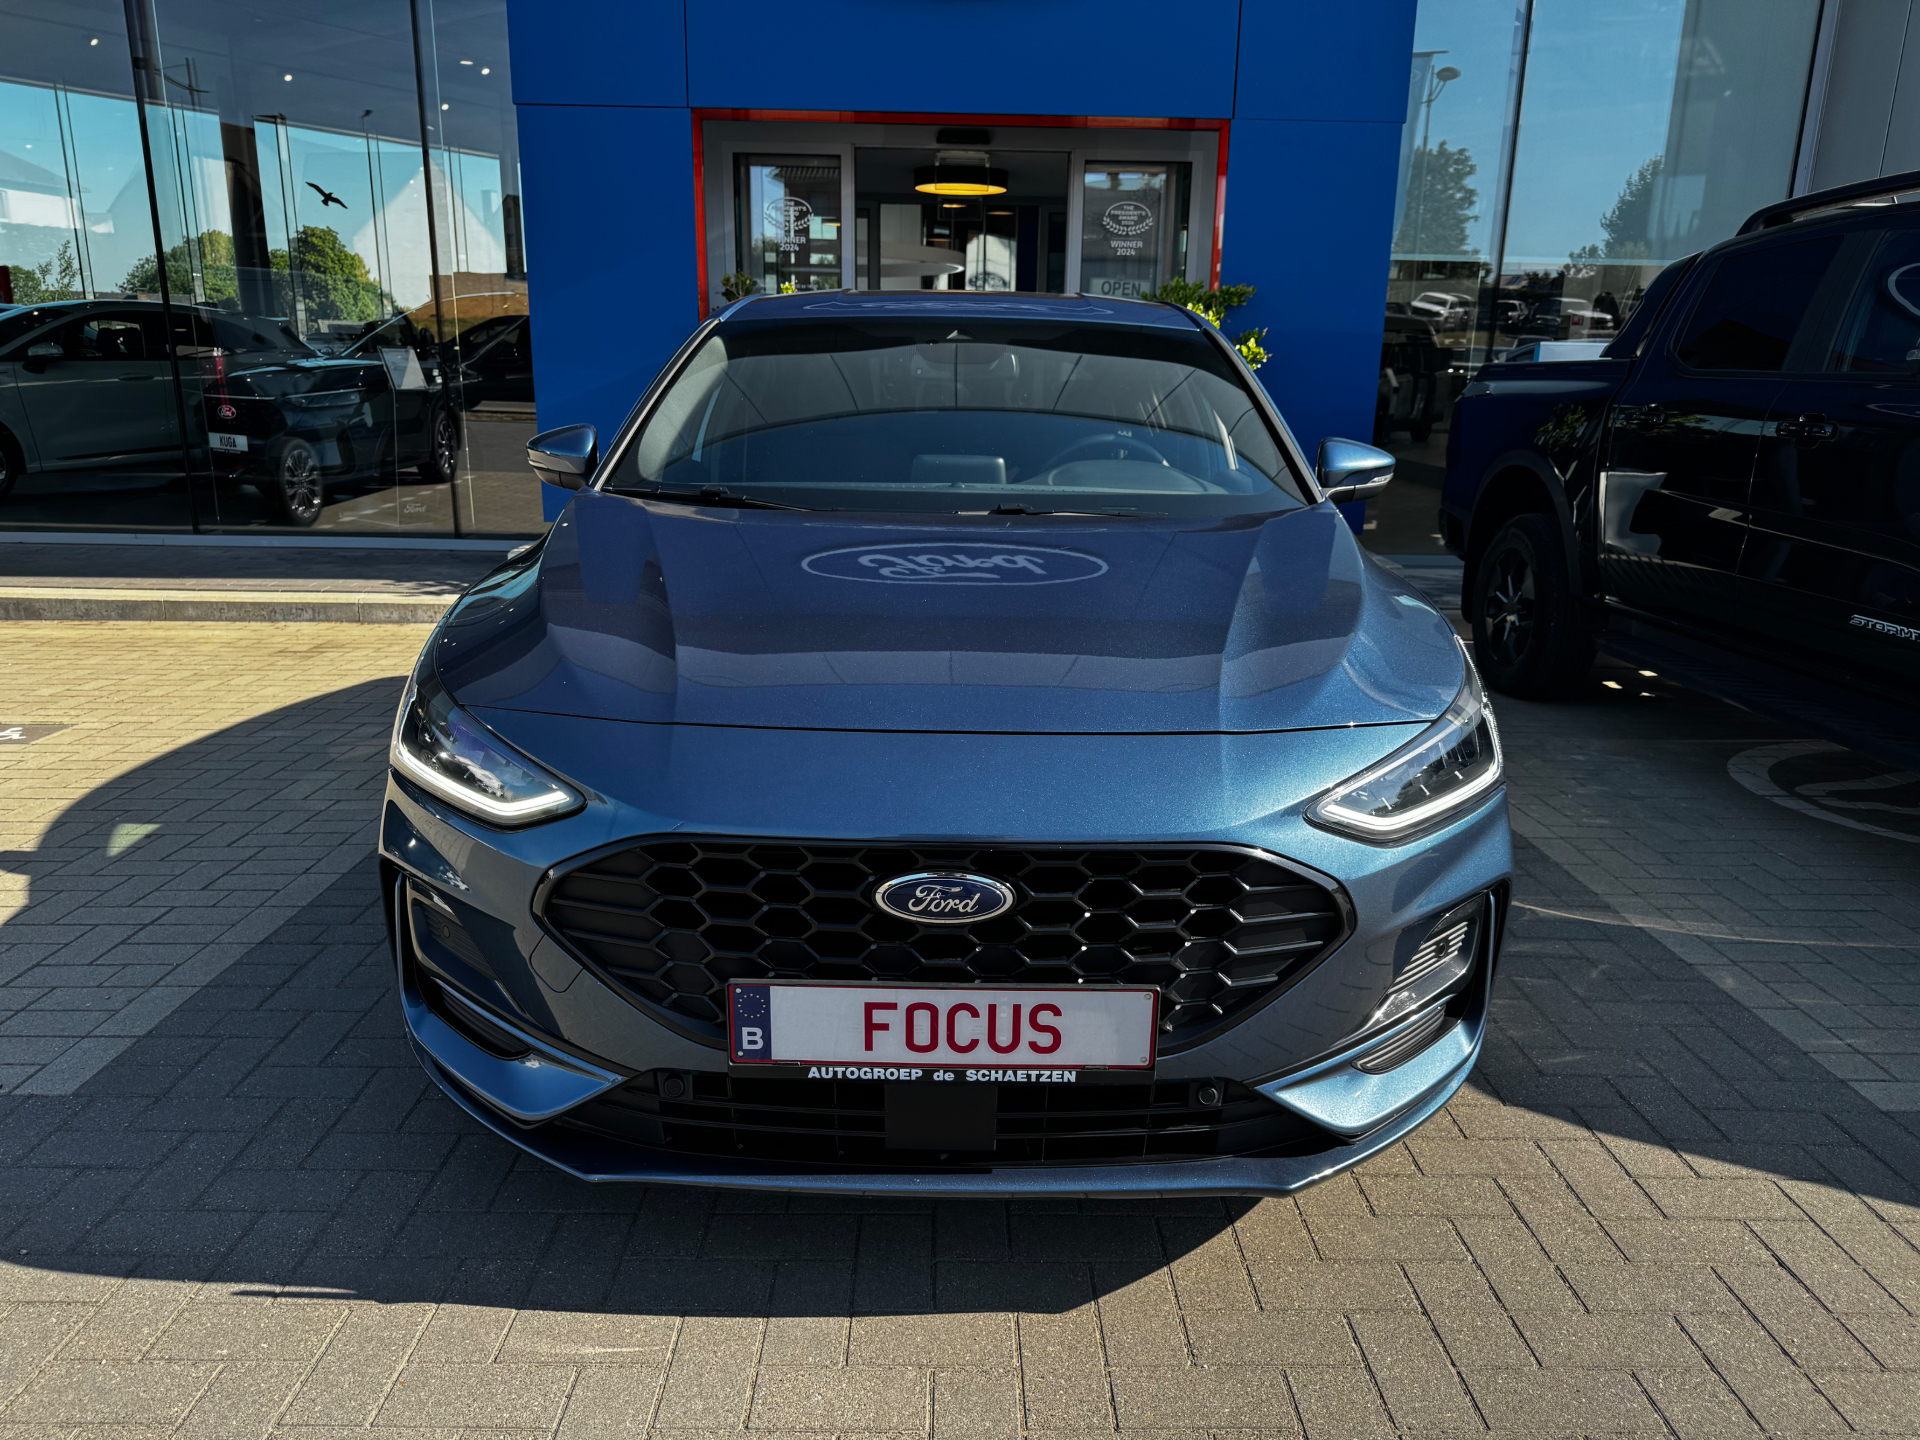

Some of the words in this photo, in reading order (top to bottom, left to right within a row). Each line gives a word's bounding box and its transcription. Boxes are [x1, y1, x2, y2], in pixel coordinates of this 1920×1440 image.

[780, 243, 799, 251] 2024
[1110, 240, 1143, 249] WINNER
[1116, 248, 1136, 256] 2024
[1101, 280, 1141, 297] OPEN
[219, 435, 237, 448] KUGA
[404, 503, 427, 513] Ford
[908, 884, 981, 913] Ford
[863, 1001, 1063, 1055] FOCUS
[741, 1026, 764, 1050] B
[807, 1066, 923, 1081] AUTOGROEP
[932, 1069, 955, 1082] de
[965, 1070, 1077, 1084] SCHAETZEN
